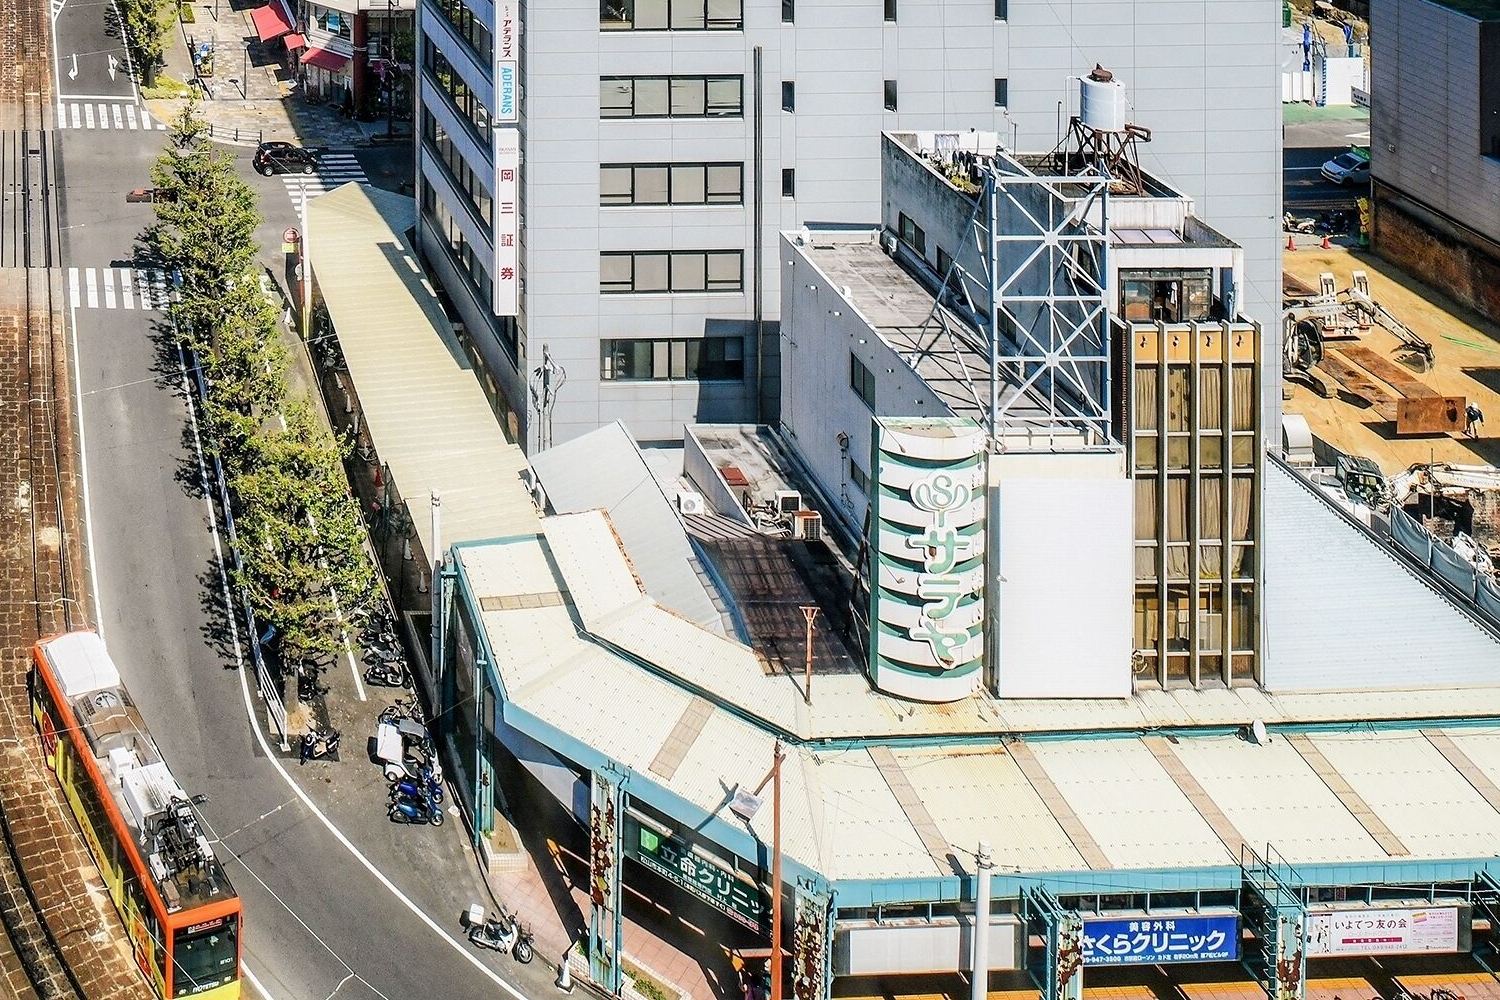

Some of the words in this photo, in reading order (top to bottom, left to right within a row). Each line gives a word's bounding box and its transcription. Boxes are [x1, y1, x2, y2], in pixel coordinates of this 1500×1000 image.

[503, 19, 512, 58] アデランス
[501, 66, 513, 114] ADERANS
[501, 168, 514, 281] 岡三証券
[911, 528, 972, 668] サラヤ
[1082, 929, 1226, 957] さくらクリニック
[1129, 920, 1176, 932] 美容外科
[1334, 918, 1408, 930] いよてつ友の会
